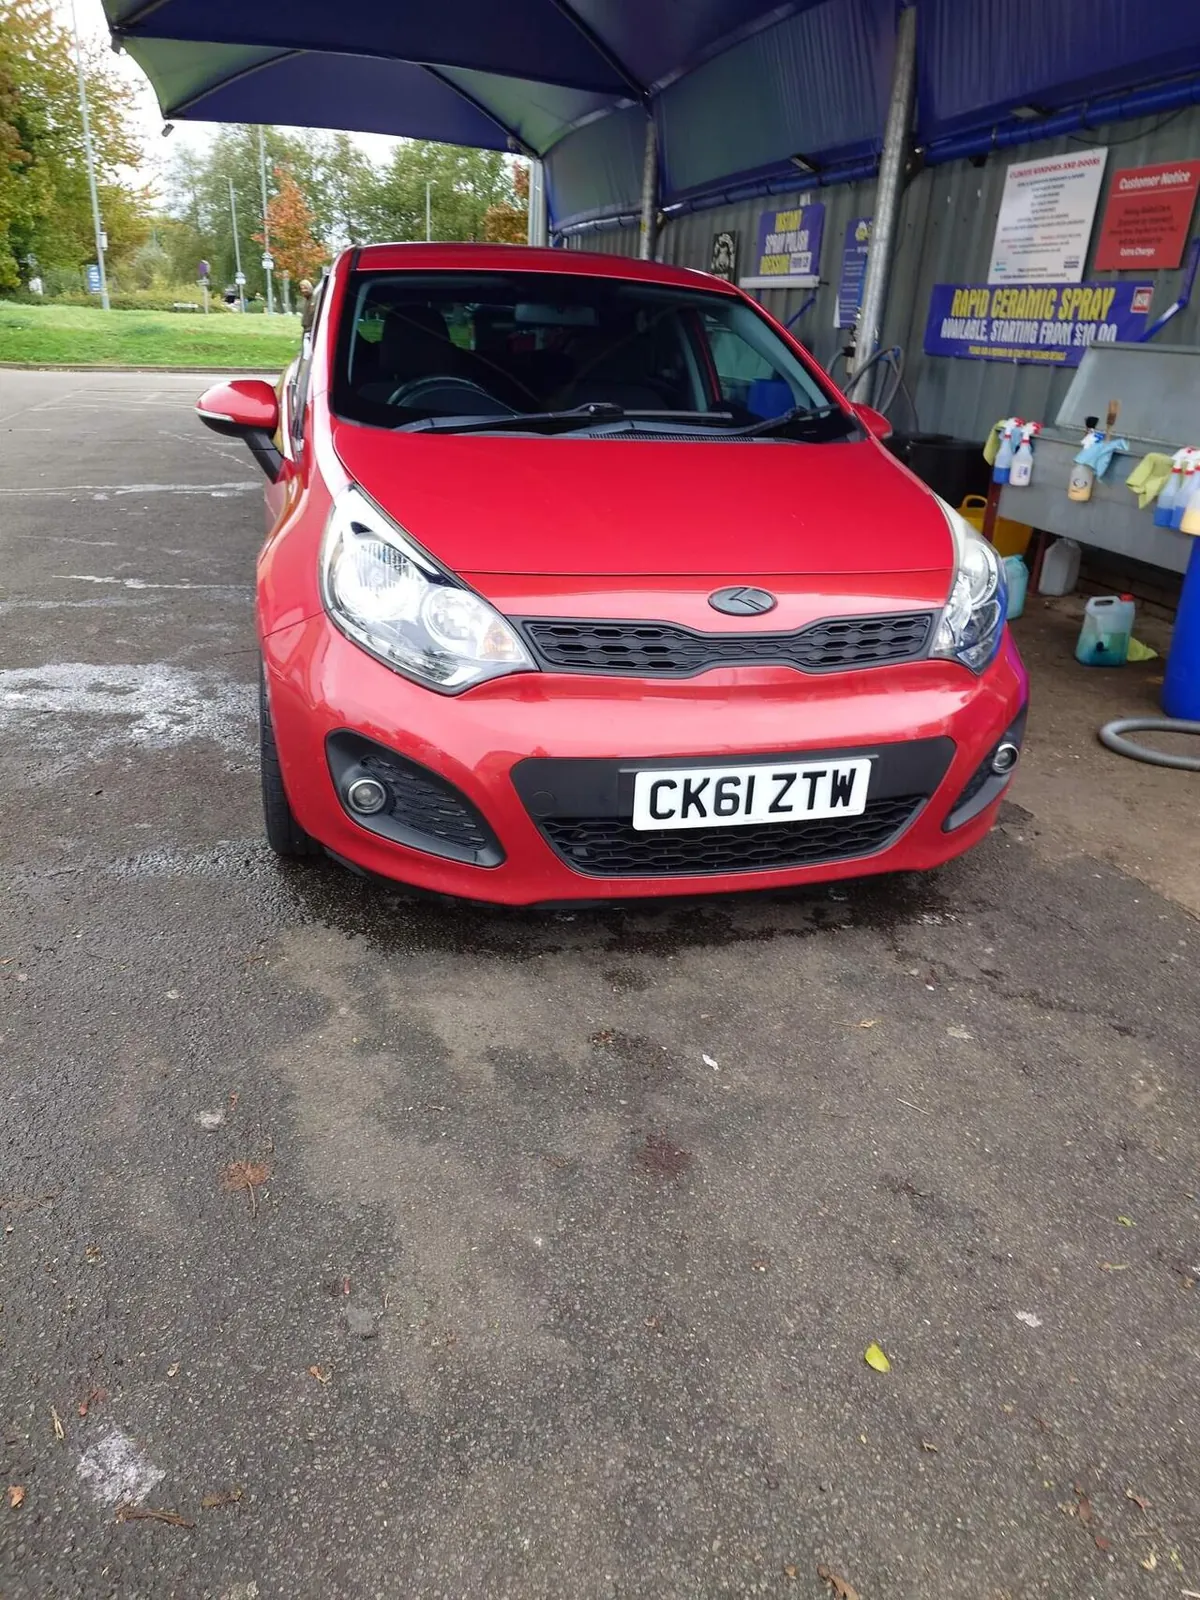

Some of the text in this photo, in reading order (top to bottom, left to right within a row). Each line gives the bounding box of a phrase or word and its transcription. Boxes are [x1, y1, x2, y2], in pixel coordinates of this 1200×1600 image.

[1119, 169, 1191, 191] Customer Notice
[765, 229, 809, 254] SPRAY POLISH
[950, 289, 991, 319] RAPID
[990, 288, 1057, 320] CERAMIC
[1057, 287, 1116, 322] SPRAY
[990, 319, 1039, 344] STARTING
[1039, 321, 1074, 346] FROM
[1073, 321, 1118, 347] £1000
[648, 767, 857, 821] CK61 ZTW
